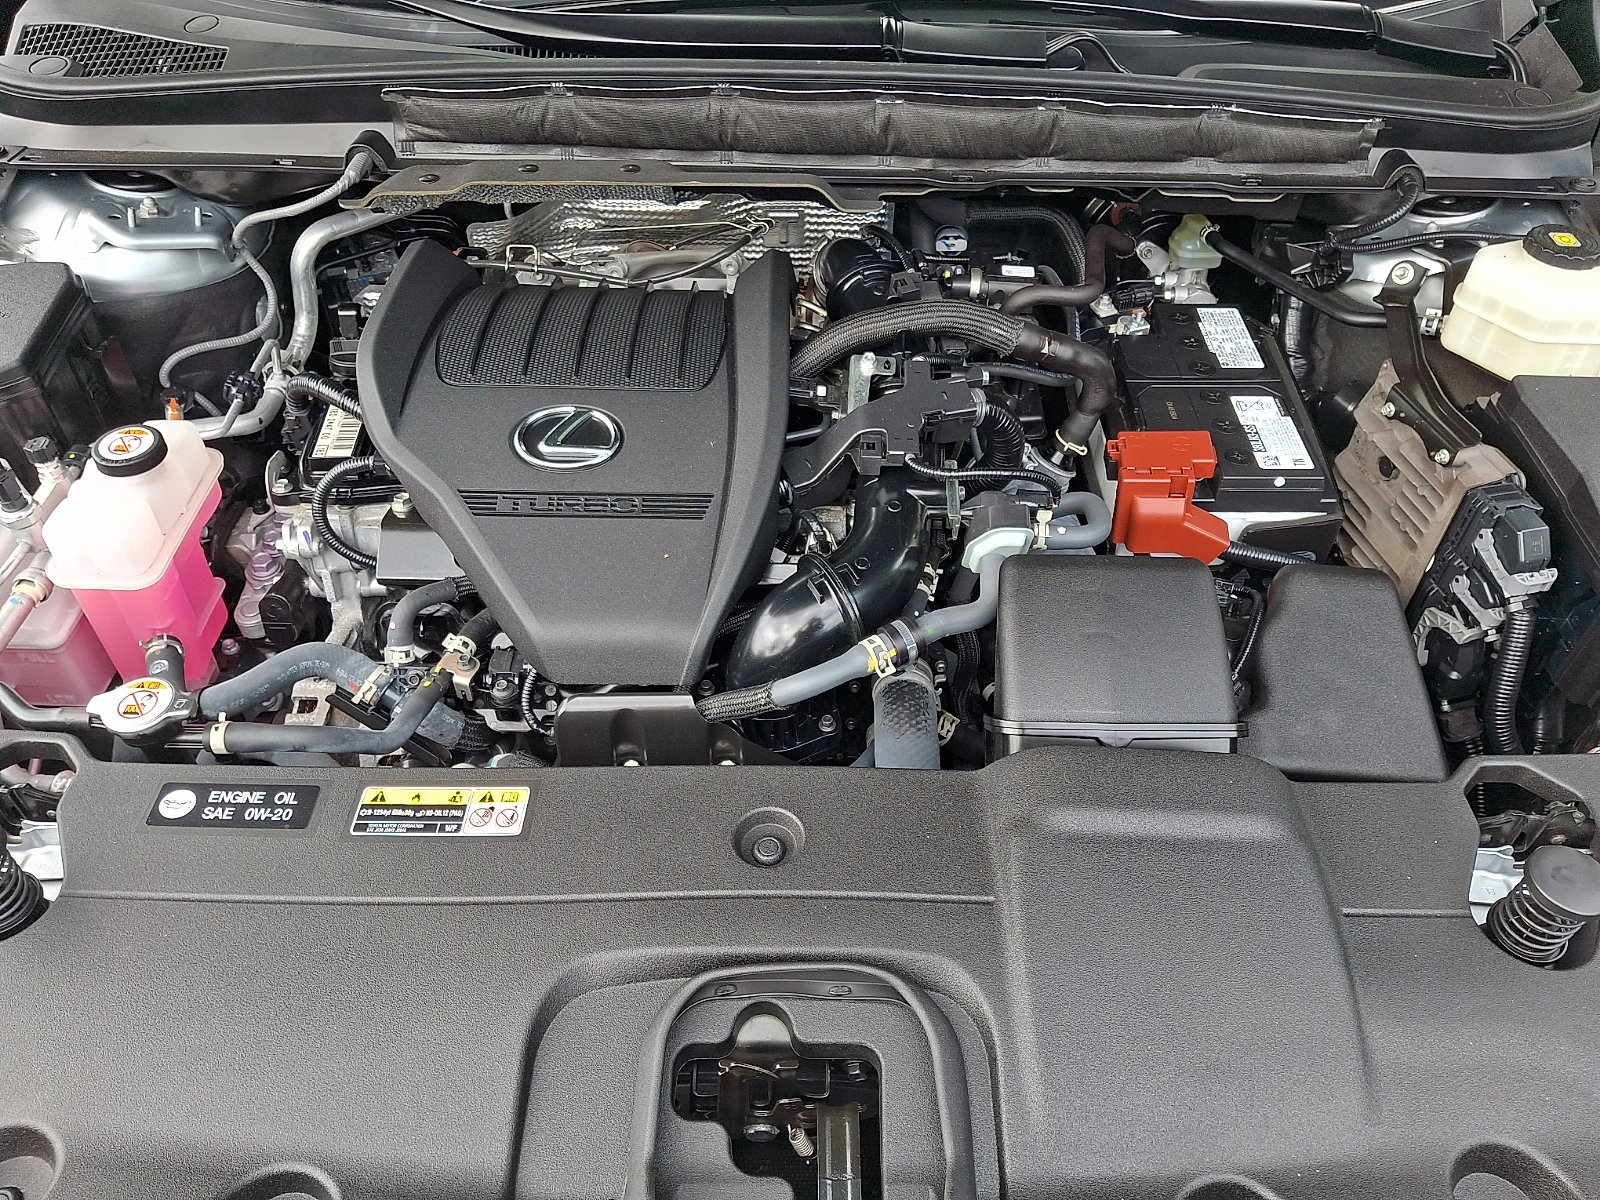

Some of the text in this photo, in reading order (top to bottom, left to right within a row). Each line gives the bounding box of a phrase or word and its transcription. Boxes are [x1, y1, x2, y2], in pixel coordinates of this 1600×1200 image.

[496, 495, 643, 513] TURBO
[208, 791, 299, 805] ENGINE OIL
[201, 807, 293, 821] SAE 0W-20
